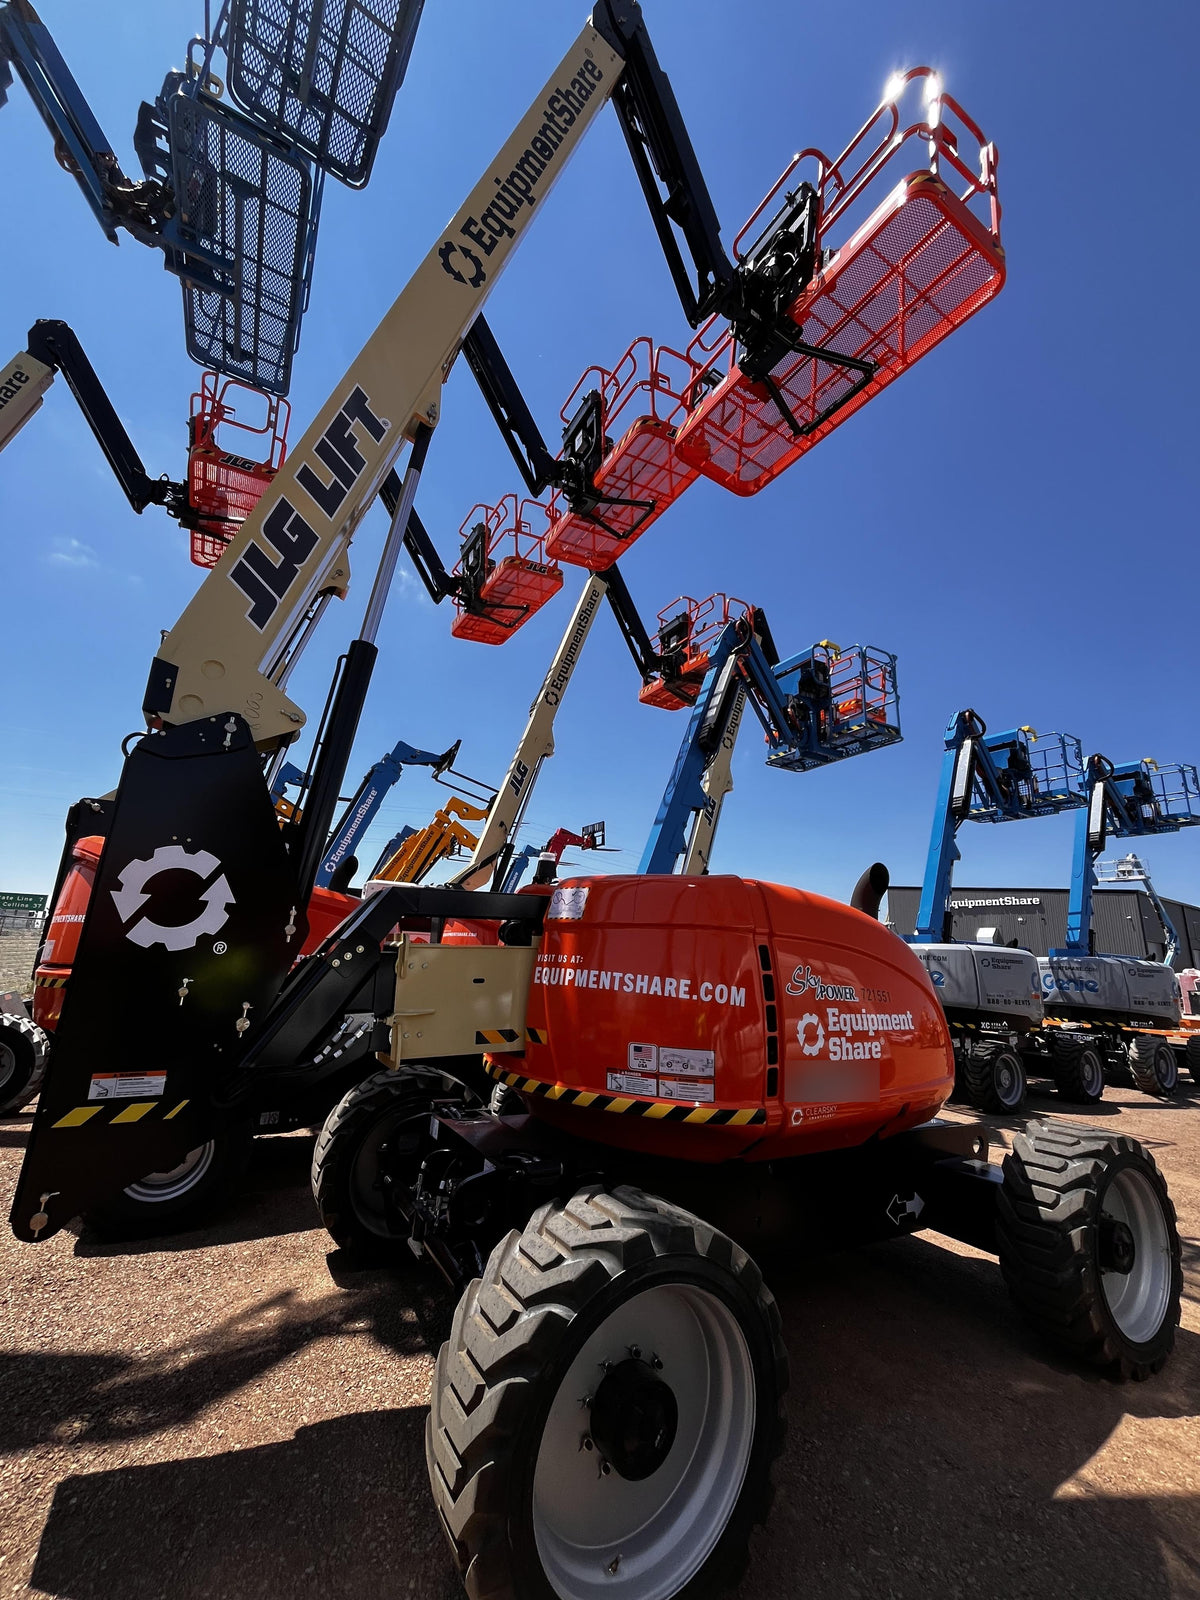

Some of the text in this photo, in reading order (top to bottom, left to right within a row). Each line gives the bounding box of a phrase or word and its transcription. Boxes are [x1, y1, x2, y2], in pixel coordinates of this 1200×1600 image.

[460, 58, 603, 256] EquipmentShare
[219, 454, 257, 472] JLG
[227, 383, 388, 634] JLG LIFT
[525, 562, 548, 575] JLG
[551, 588, 600, 691] EquipmentShare
[509, 759, 530, 798] JLG
[331, 788, 378, 863] EquipmentShare
[945, 896, 1040, 909] quipmentShare
[537, 953, 584, 964] VISIT US AT:
[534, 966, 746, 1007] EQUIPMENTSHARE.COM
[786, 965, 859, 1002] Sky POWER
[861, 988, 891, 1002] 721551
[827, 1008, 914, 1036] Equipment
[829, 1037, 881, 1060] Share
[805, 1105, 838, 1116] CLEARSKY
